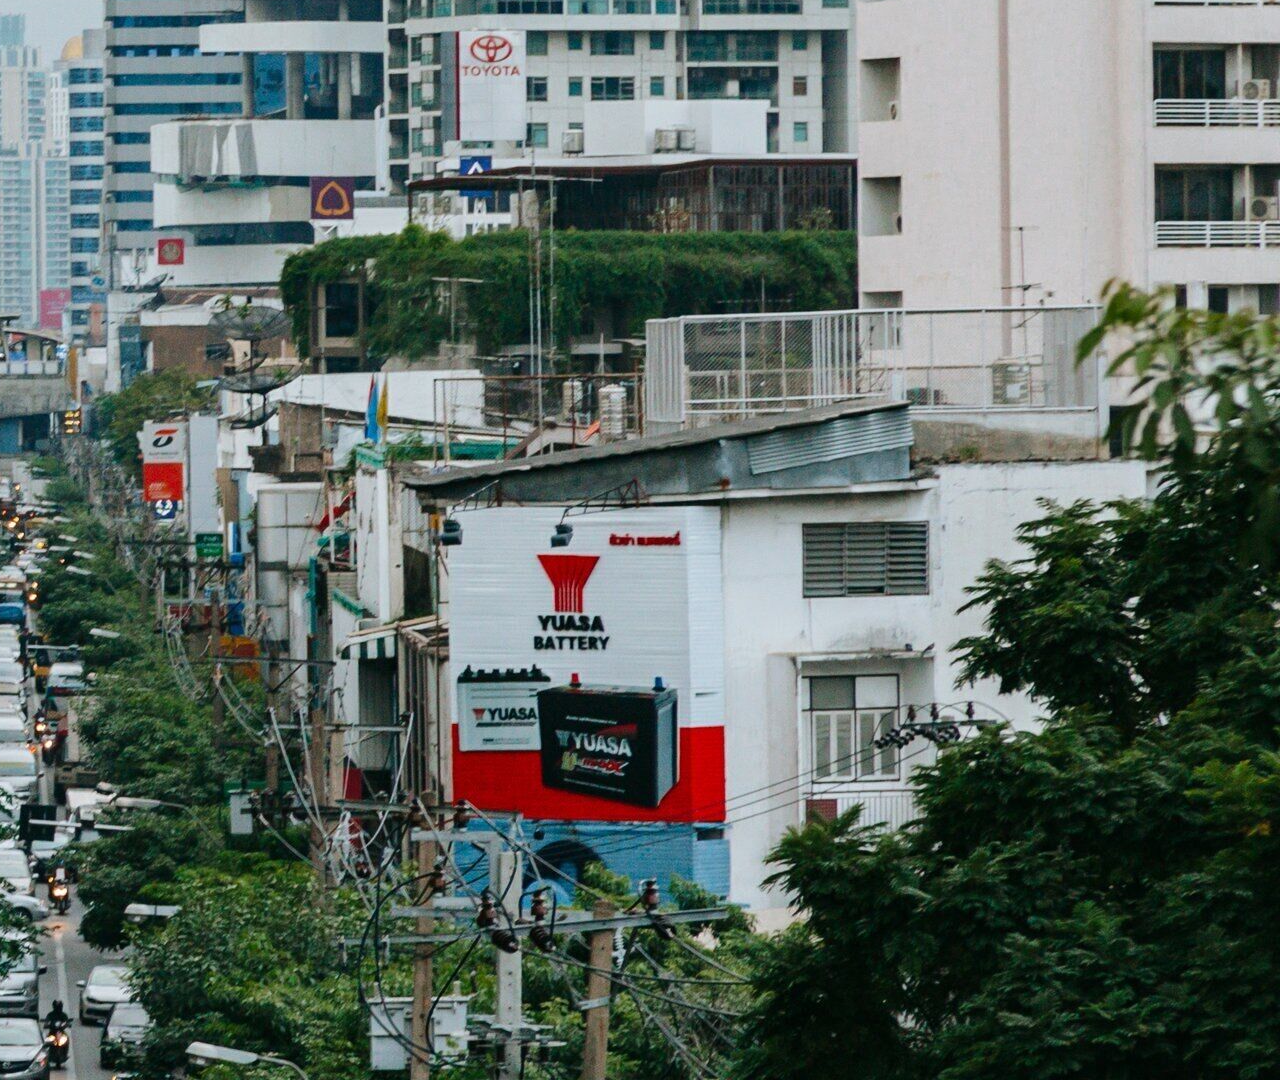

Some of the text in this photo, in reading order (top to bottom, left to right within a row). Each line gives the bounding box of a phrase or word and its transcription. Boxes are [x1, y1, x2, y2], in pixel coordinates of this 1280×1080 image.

[462, 66, 521, 77] TOYOTA
[538, 615, 605, 633] YUASA
[534, 636, 609, 651] BATTERY
[488, 706, 538, 721] YUASA
[571, 731, 633, 758] YUASA
